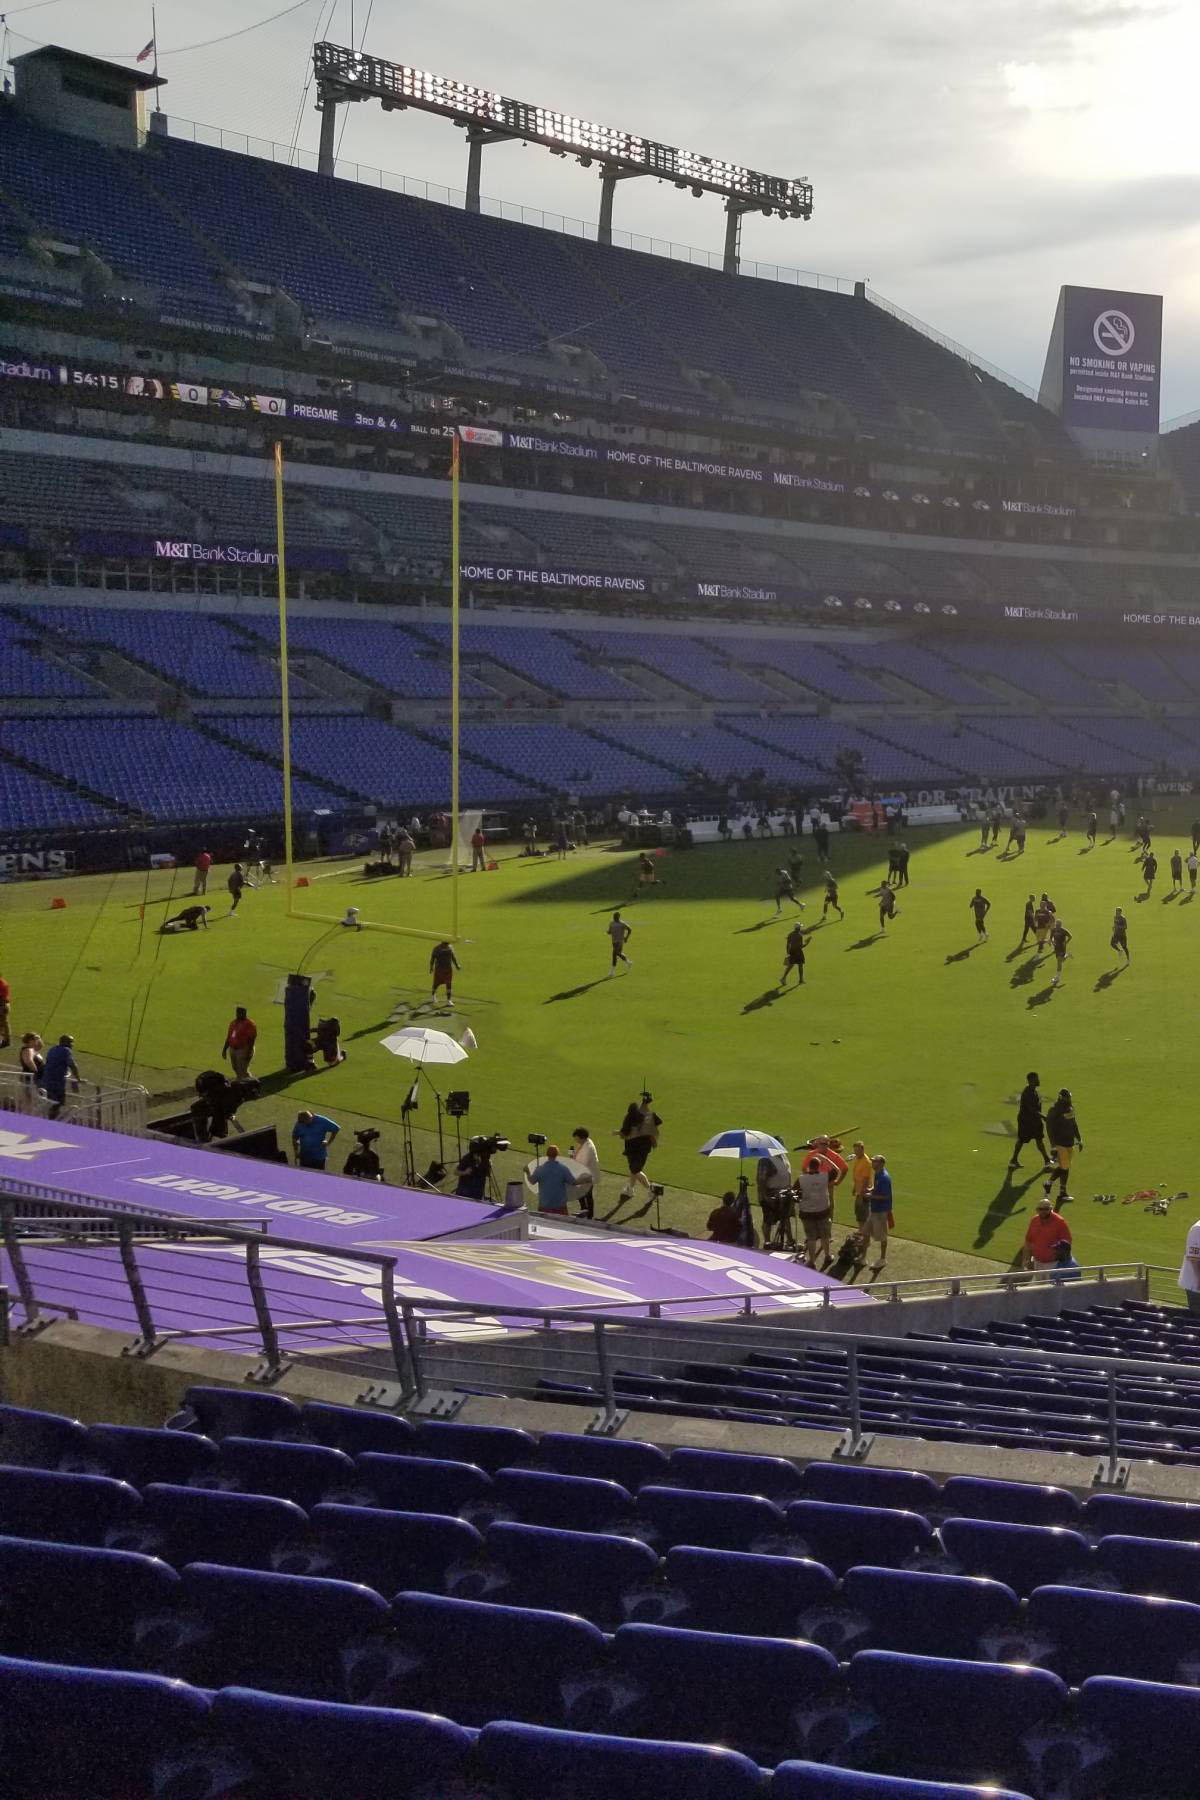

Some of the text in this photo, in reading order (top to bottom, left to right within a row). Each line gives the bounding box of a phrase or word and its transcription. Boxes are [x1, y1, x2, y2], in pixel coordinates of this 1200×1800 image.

[1069, 356, 1156, 374] NO SMOKING OR VAPING
[73, 371, 119, 389] 54:15
[188, 387, 455, 437] 0 0 PREGAME 3RD & 4 BALL ON 25
[510, 434, 534, 449] M&T
[534, 437, 559, 452] Bank
[560, 441, 598, 459] Stadium
[607, 449, 763, 481] HOME OF THE BALTIMORE RAVENS
[773, 472, 845, 492] M&T Bank Stadium
[1002, 500, 1024, 512] M&T
[155, 540, 279, 564] M&T Bank Stadium
[459, 565, 645, 590] HOME OF THE BALTIMORE RAVENS
[698, 583, 776, 600] M&T Bank Stadium
[1004, 606, 1078, 621] M&T Bank Stadium
[1123, 613, 1151, 624] HOME
[1153, 614, 1166, 624] OF
[1168, 615, 1187, 625] THE
[1151, 781, 1193, 793] AVENS
[133, 1174, 379, 1225] BUD LIGHT
